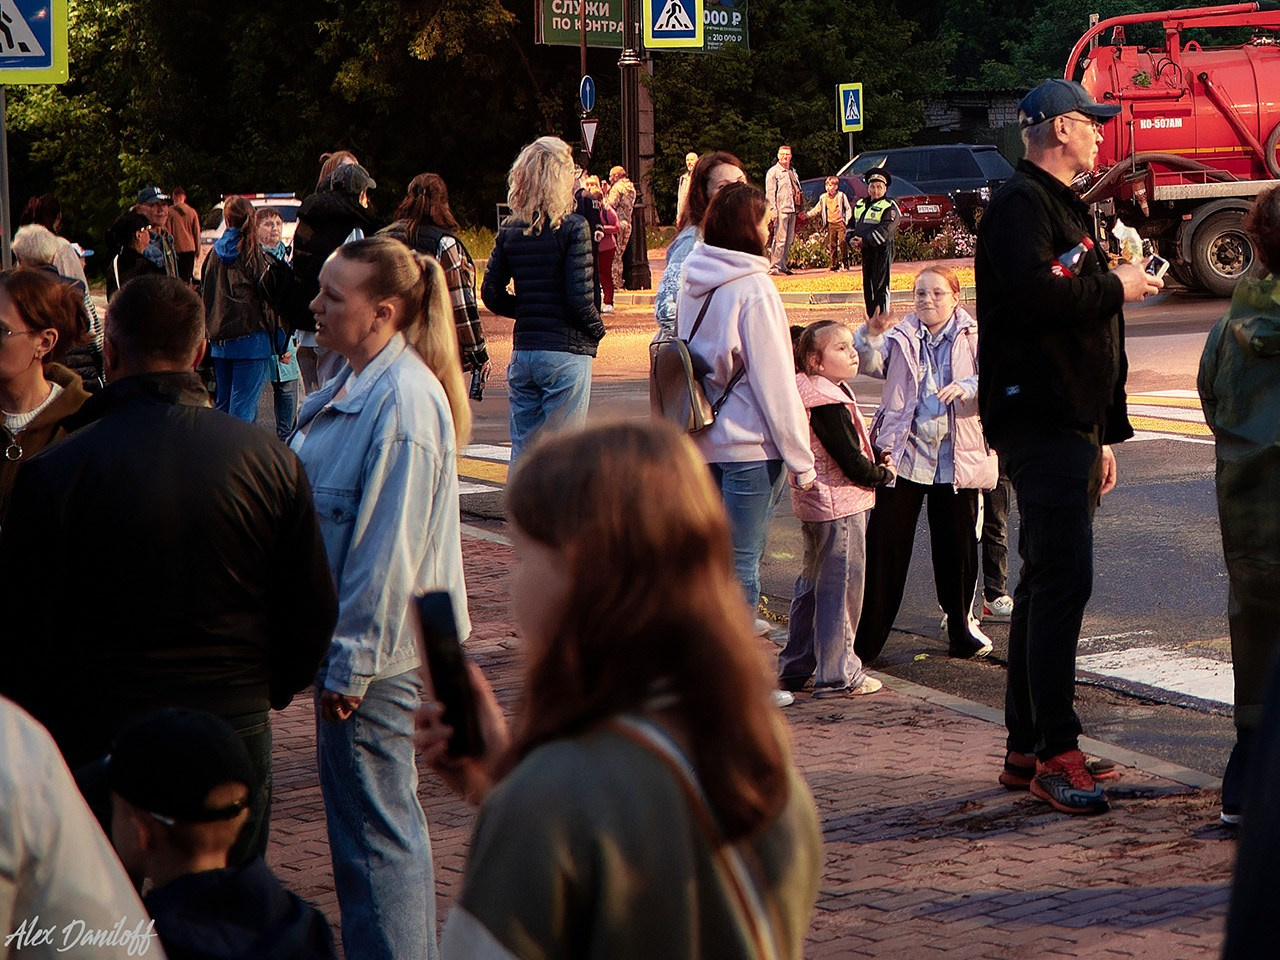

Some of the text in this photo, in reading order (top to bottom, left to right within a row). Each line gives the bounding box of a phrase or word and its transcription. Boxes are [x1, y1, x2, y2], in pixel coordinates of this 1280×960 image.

[552, 0, 610, 17] СЛУЖИ
[552, 17, 640, 34] ПО КОНТРАТ
[1140, 118, 1183, 129] КО-507АМ
